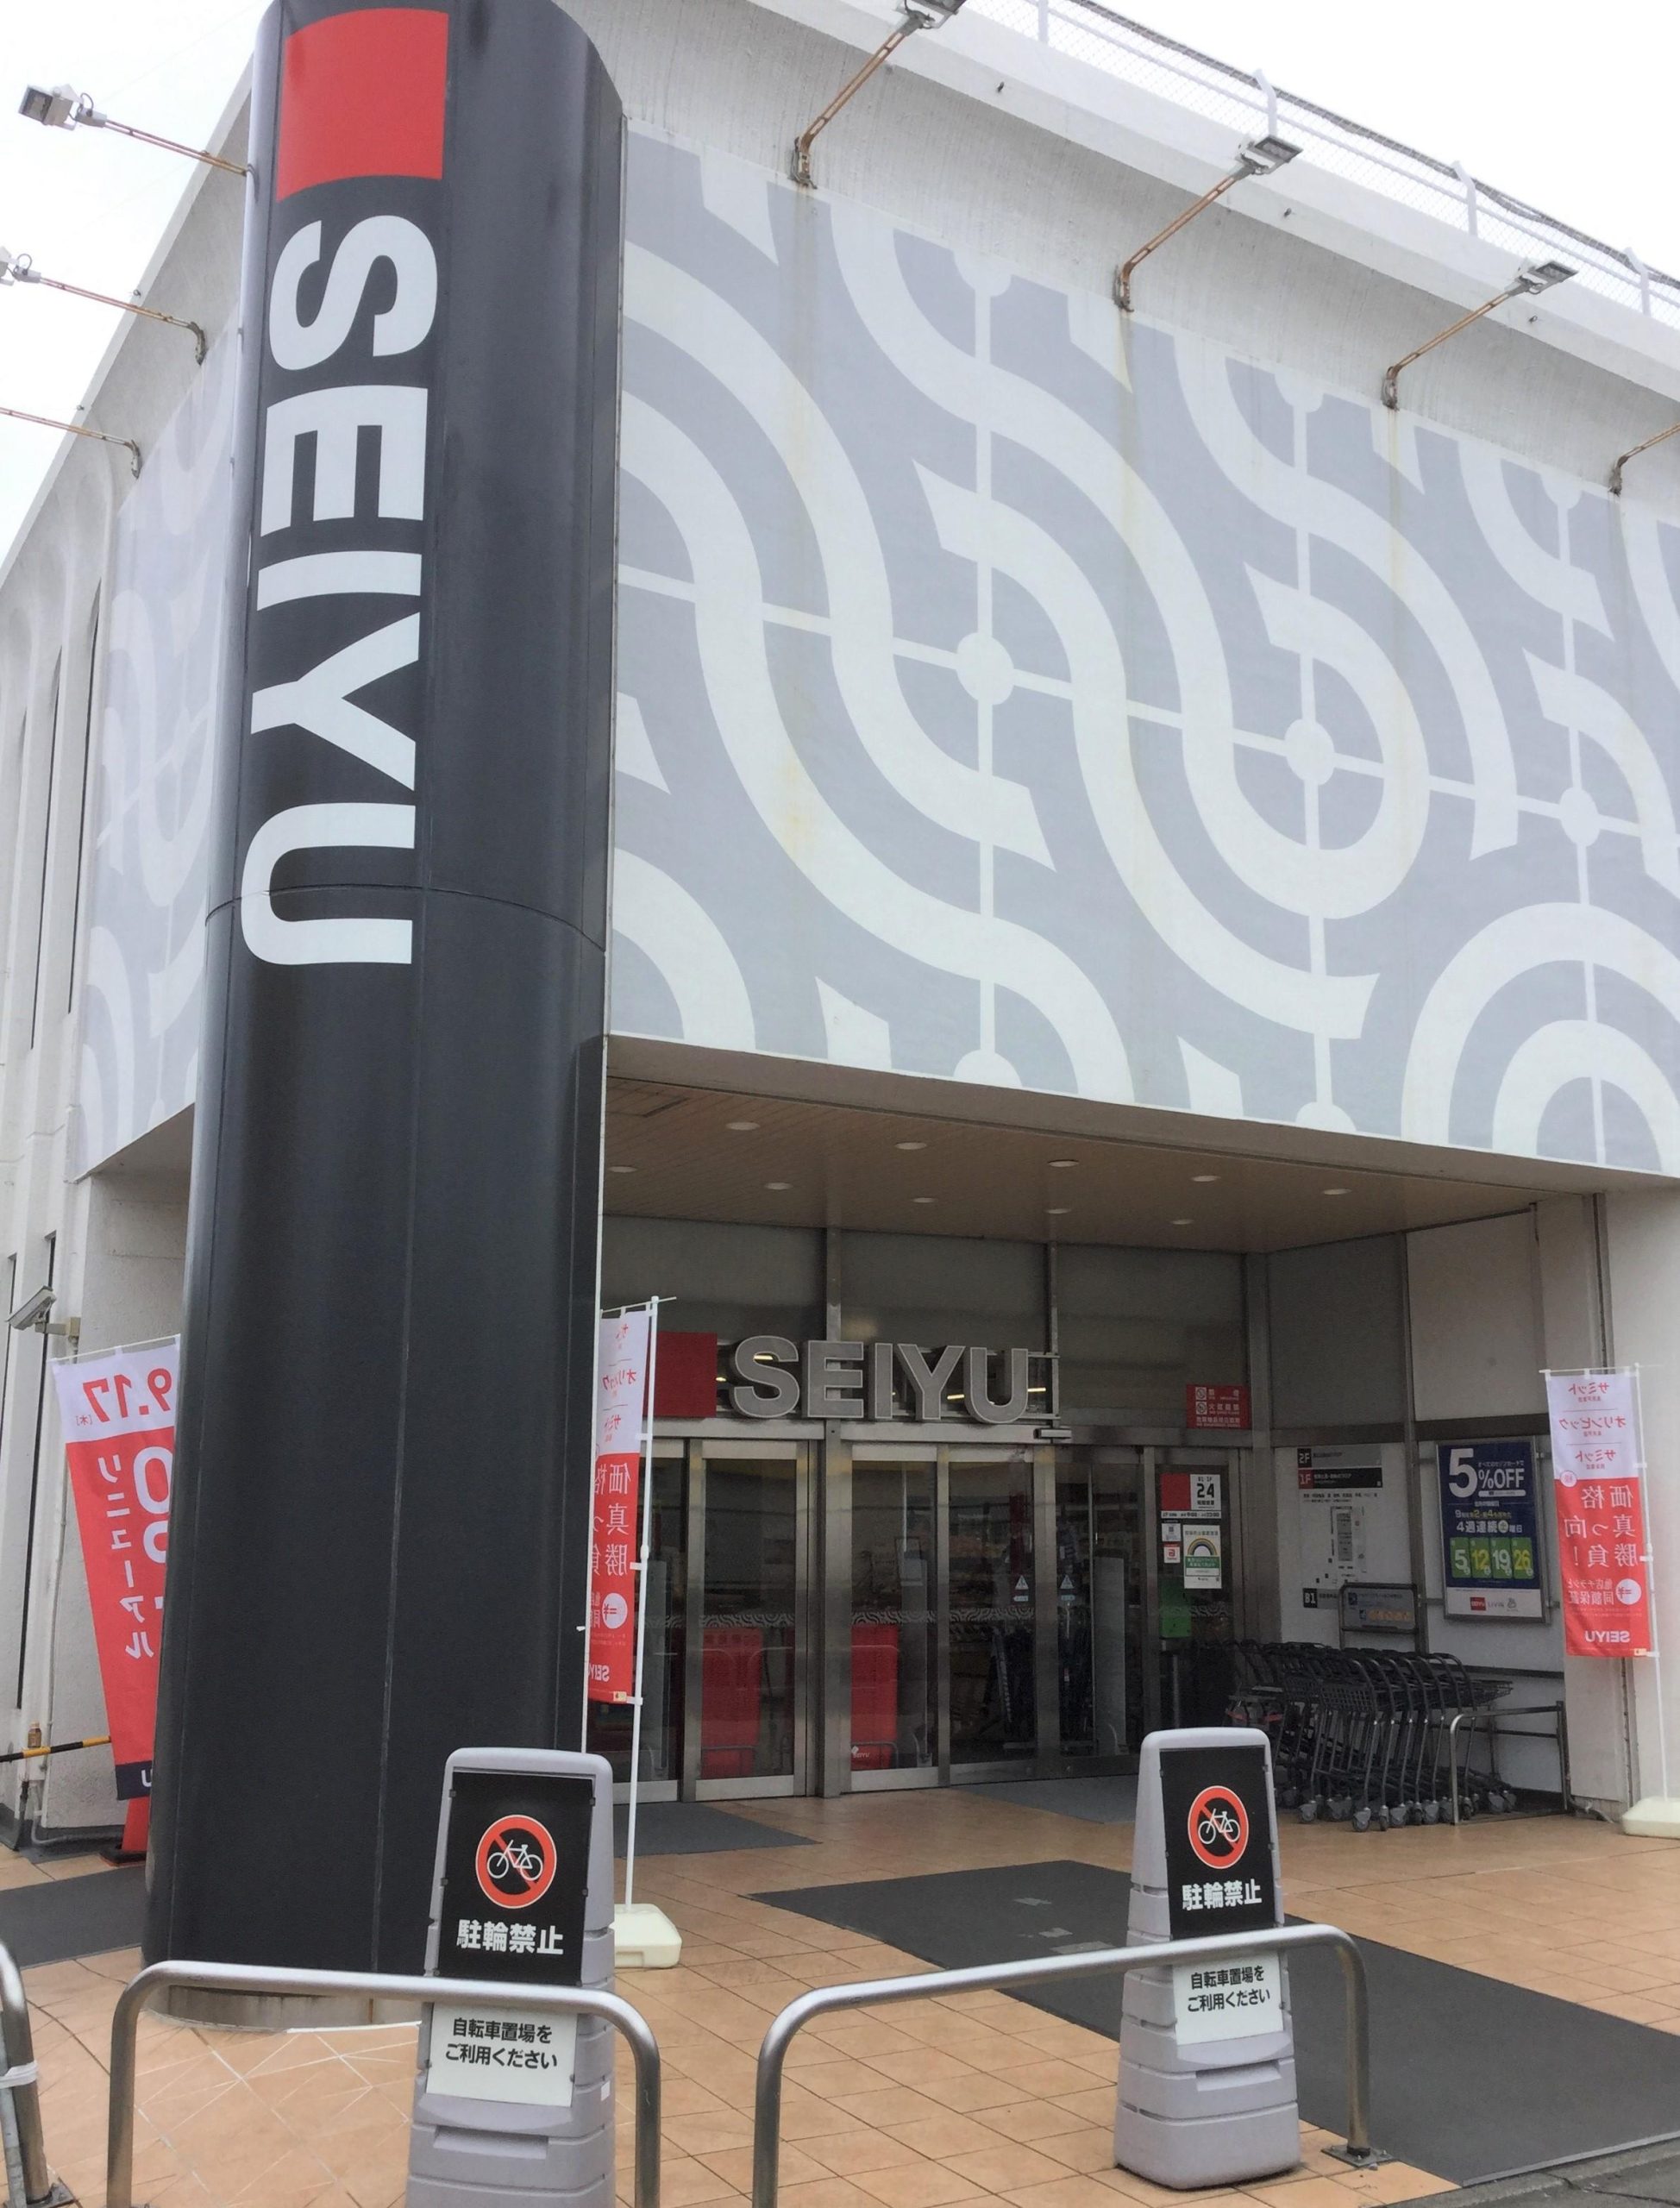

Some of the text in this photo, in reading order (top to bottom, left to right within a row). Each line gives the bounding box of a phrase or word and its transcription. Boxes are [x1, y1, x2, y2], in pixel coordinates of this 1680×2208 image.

[241, 213, 437, 966] SEIYU
[730, 1335, 1028, 1423] SEIYU
[1299, 1452, 1310, 1464] 2F
[1300, 1473, 1311, 1484] 1F
[1449, 1448, 1524, 1497] 5 %OFF
[1197, 1483, 1214, 1498] 24
[1305, 1593, 1316, 1603] B1
[1182, 1879, 1263, 1911] 駐輪禁止
[456, 1917, 565, 1956] 駐輪禁止
[1190, 1965, 1265, 1990] 自転車置場を
[1187, 1988, 1271, 2012] ご利用ください
[452, 2017, 553, 2044] 自転車置場を
[445, 2043, 558, 2070] ご利用ください
